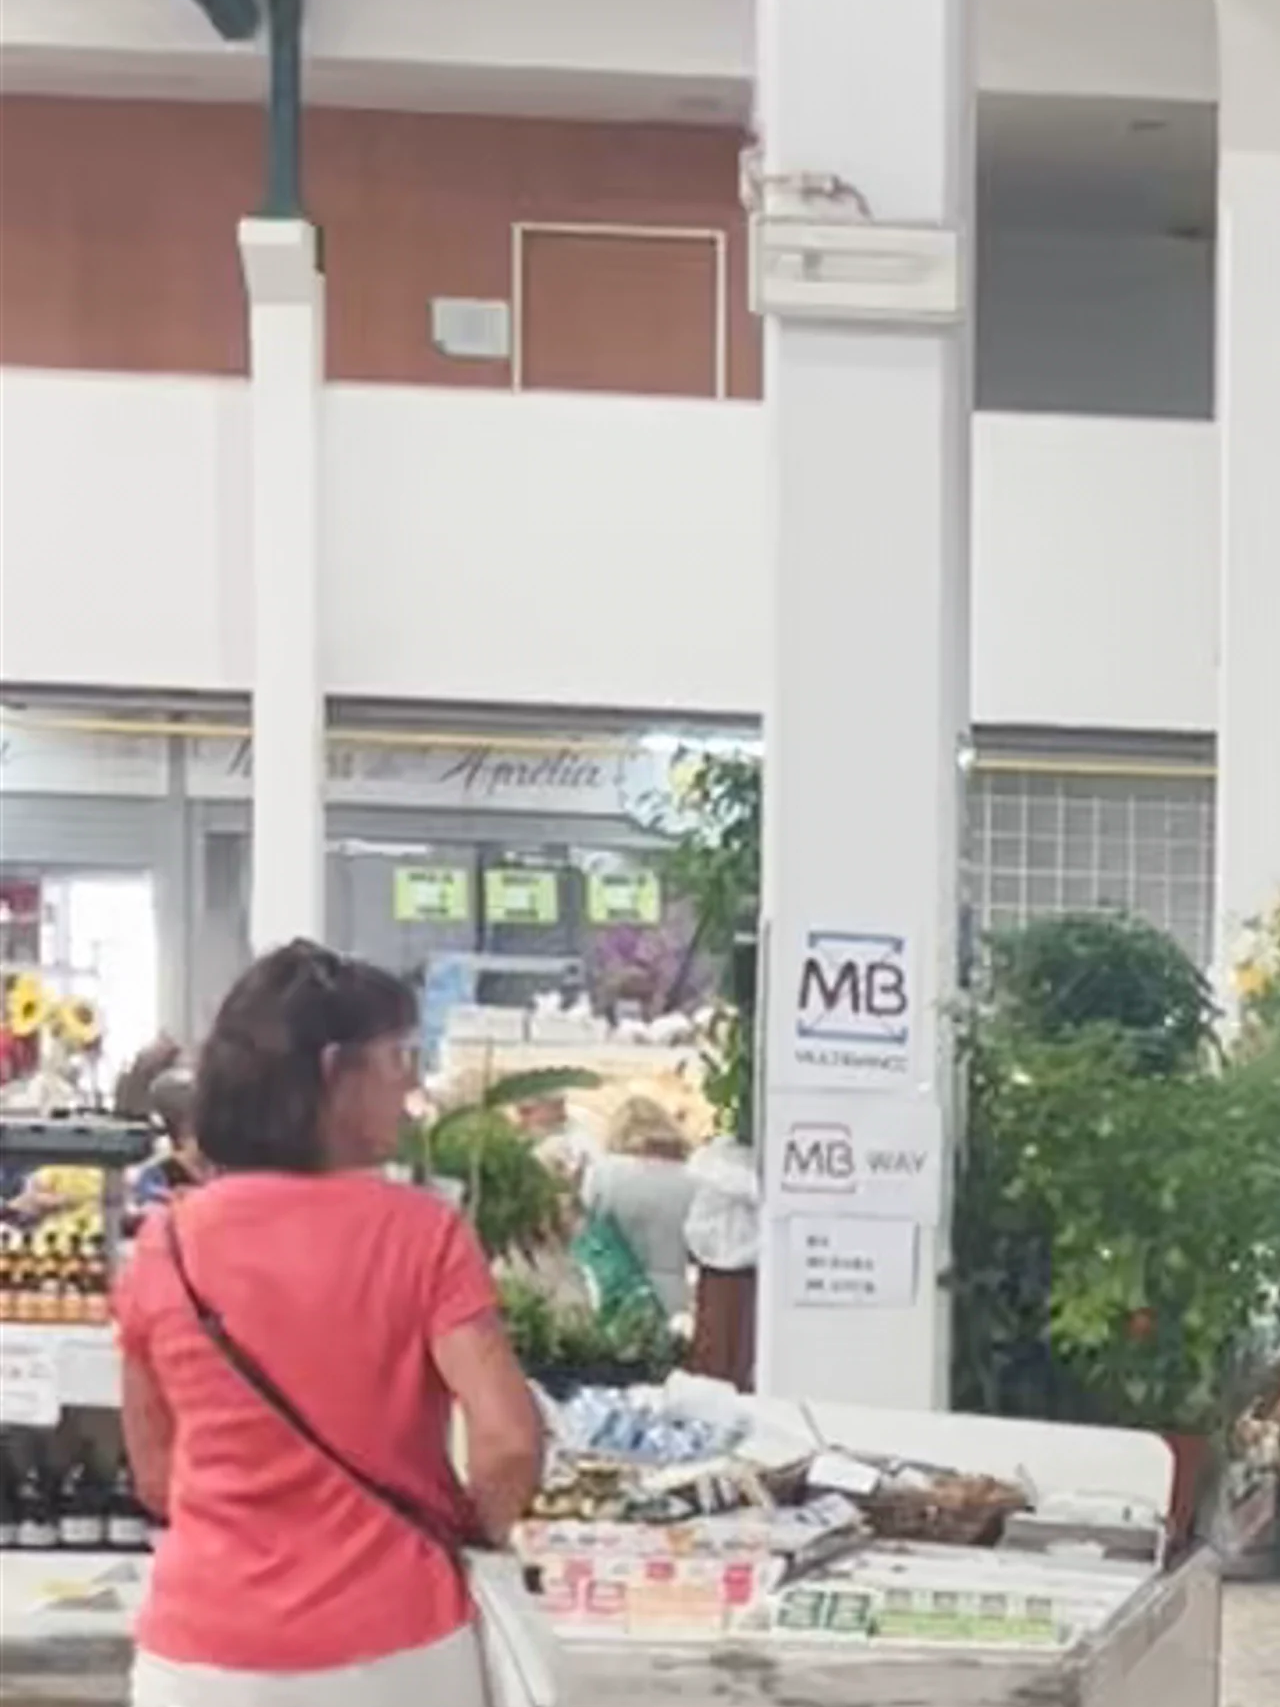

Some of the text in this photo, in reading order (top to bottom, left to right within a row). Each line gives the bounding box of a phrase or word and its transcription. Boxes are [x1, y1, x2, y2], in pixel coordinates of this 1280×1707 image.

[798, 959, 907, 1016] MB
[784, 1139, 927, 1179] MB WAY
